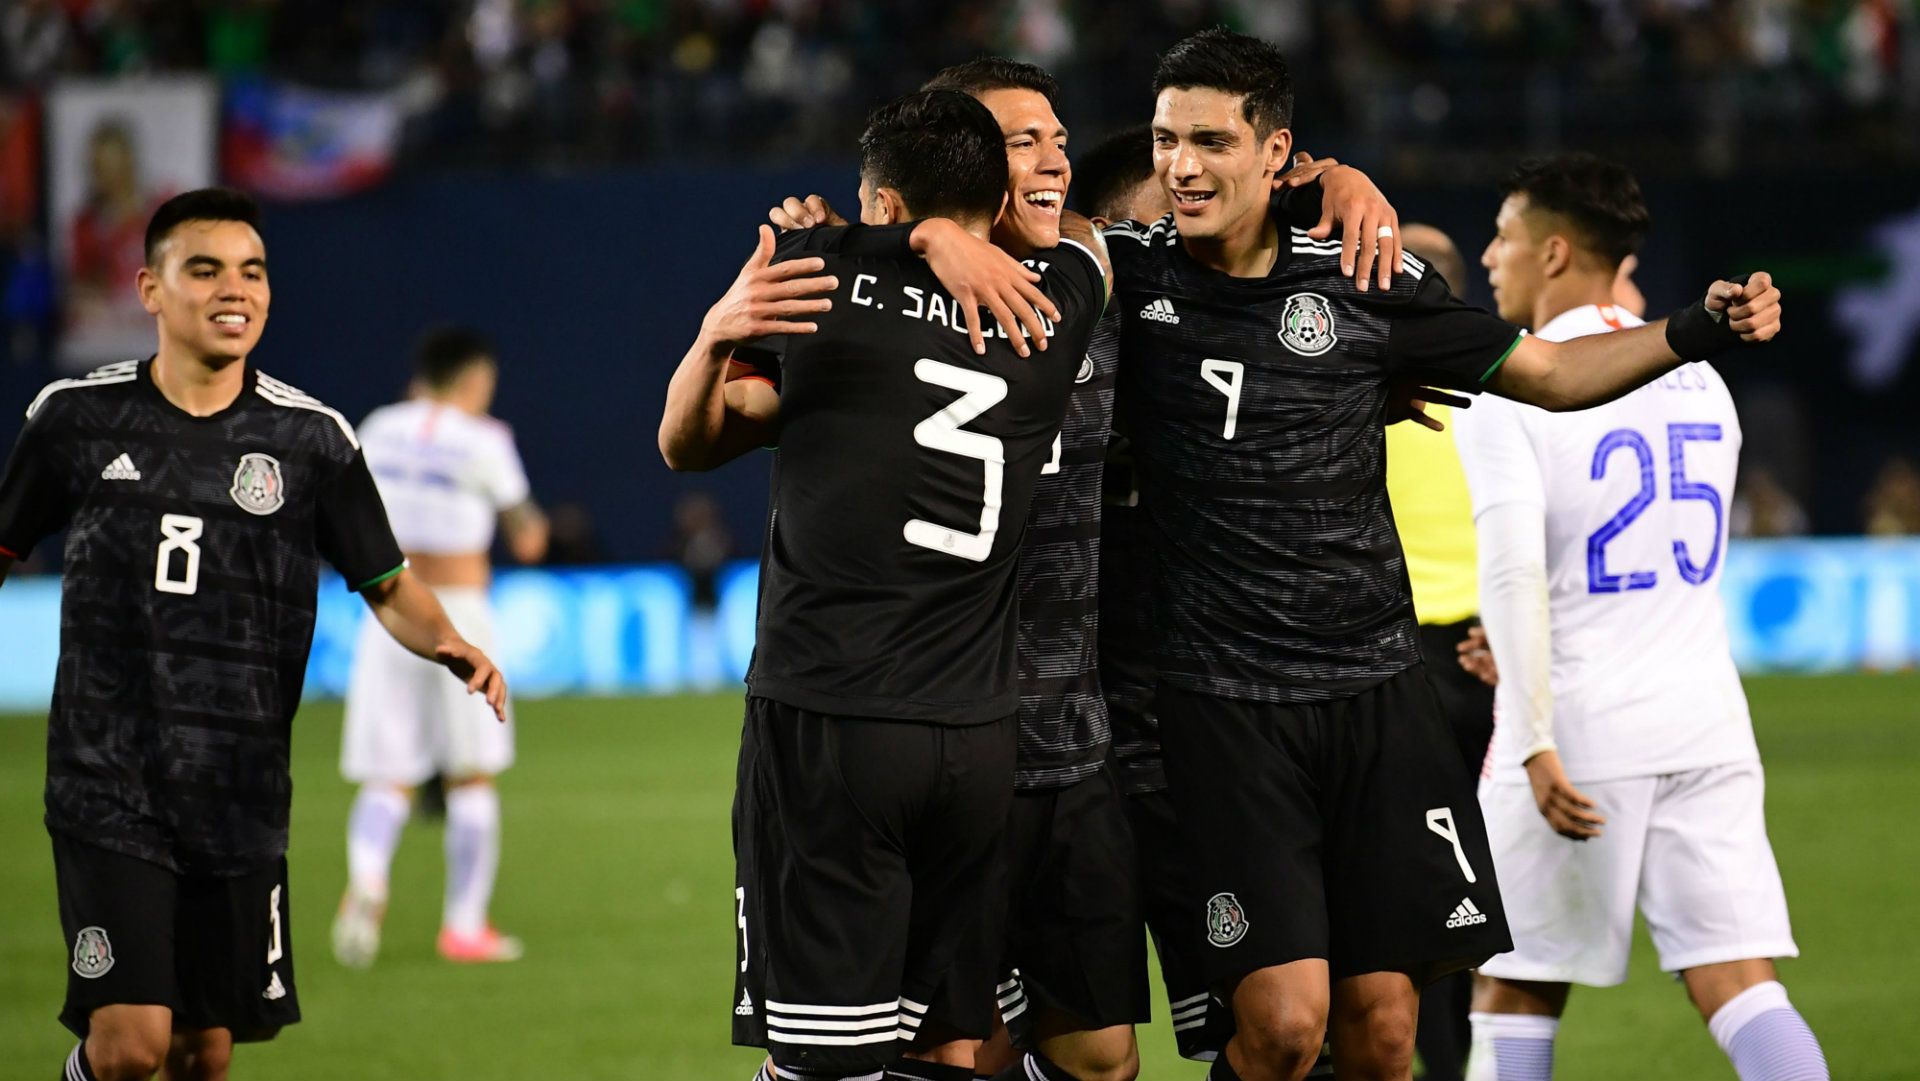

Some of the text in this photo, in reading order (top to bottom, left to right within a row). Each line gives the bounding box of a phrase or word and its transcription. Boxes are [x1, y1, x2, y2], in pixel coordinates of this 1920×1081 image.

[851, 273, 884, 310] C.
[1139, 309, 1180, 325] adidas
[1200, 358, 1245, 440] 9
[101, 469, 142, 481] adidas
[903, 357, 1008, 562] 3
[1587, 422, 1724, 594] 25
[155, 513, 204, 595] 8
[1426, 807, 1477, 883] 9
[1445, 913, 1488, 929] adidas
